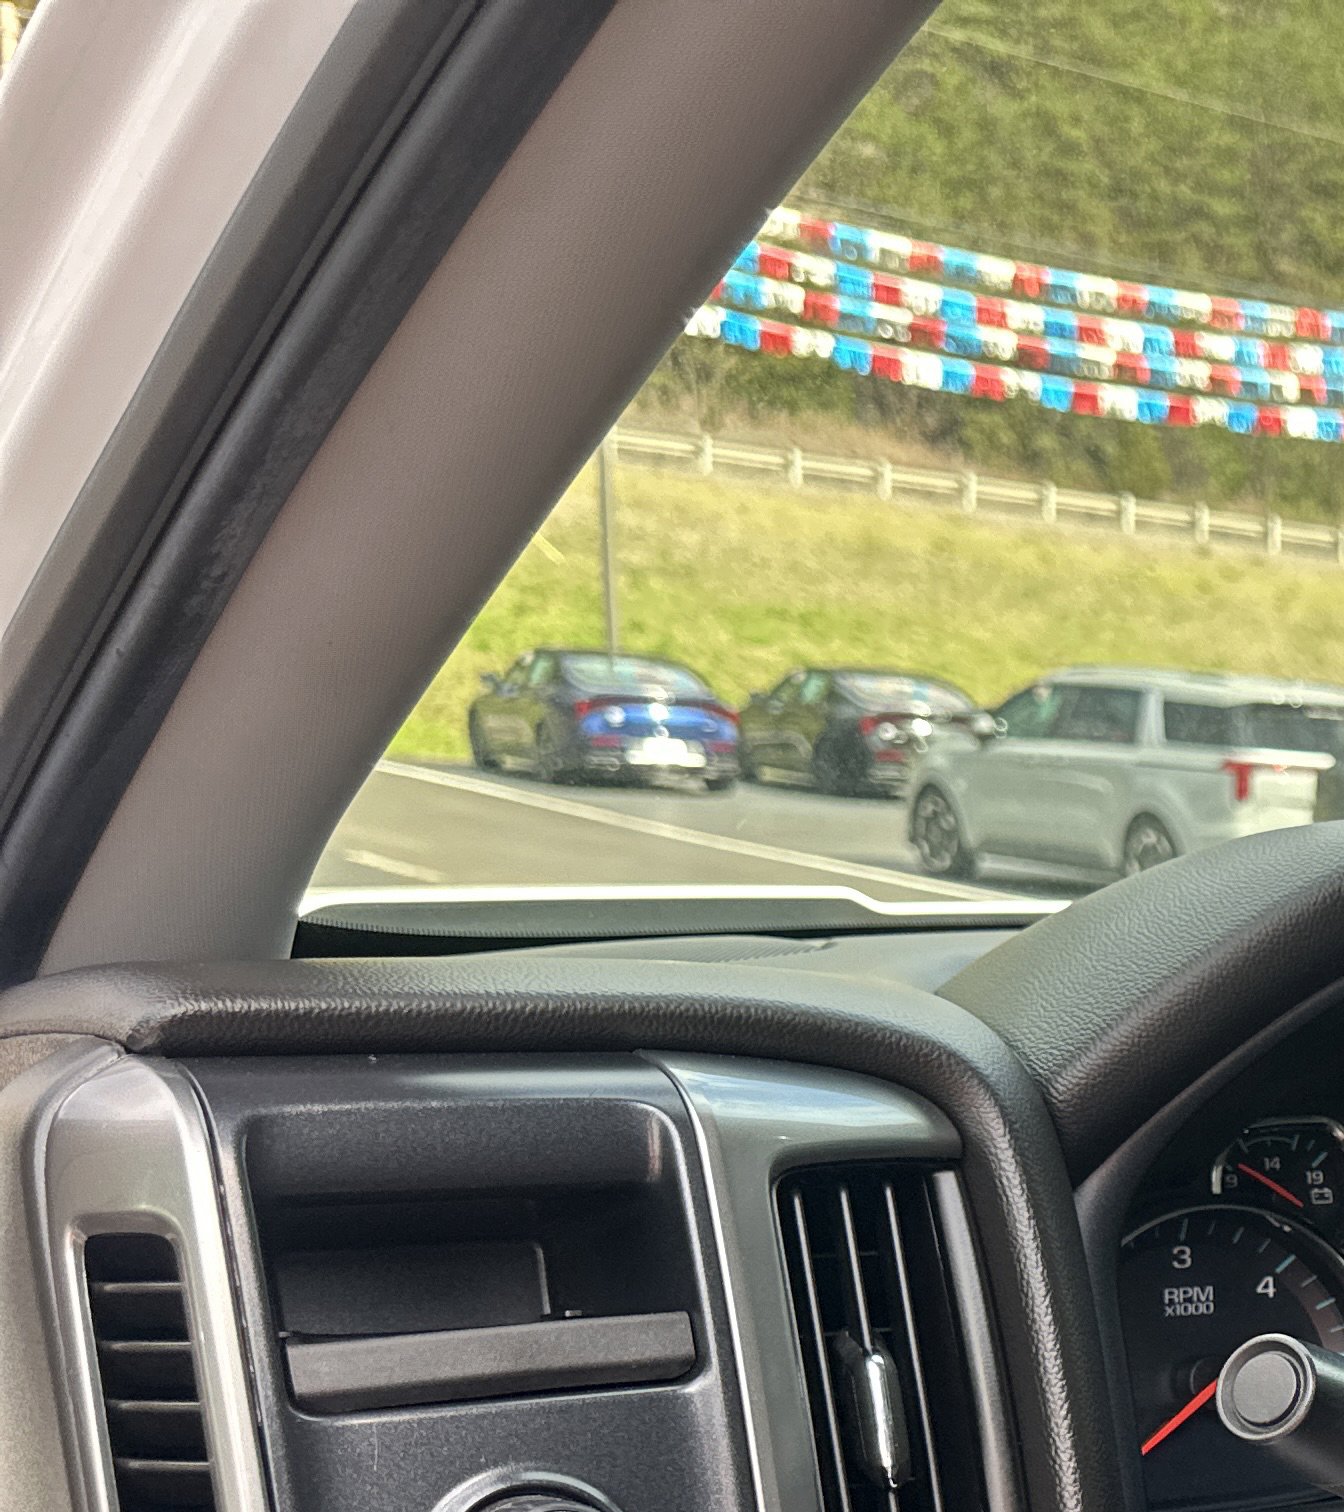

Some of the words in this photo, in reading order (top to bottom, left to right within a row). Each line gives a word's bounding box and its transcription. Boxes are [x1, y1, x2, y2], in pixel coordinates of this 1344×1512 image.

[1264, 1157, 1280, 1170] 14
[1306, 1170, 1324, 1184] 19
[1172, 1246, 1192, 1269] 3
[1164, 1286, 1215, 1304] RPM
[1256, 1276, 1277, 1298] 4
[1165, 1302, 1215, 1317] x1000
